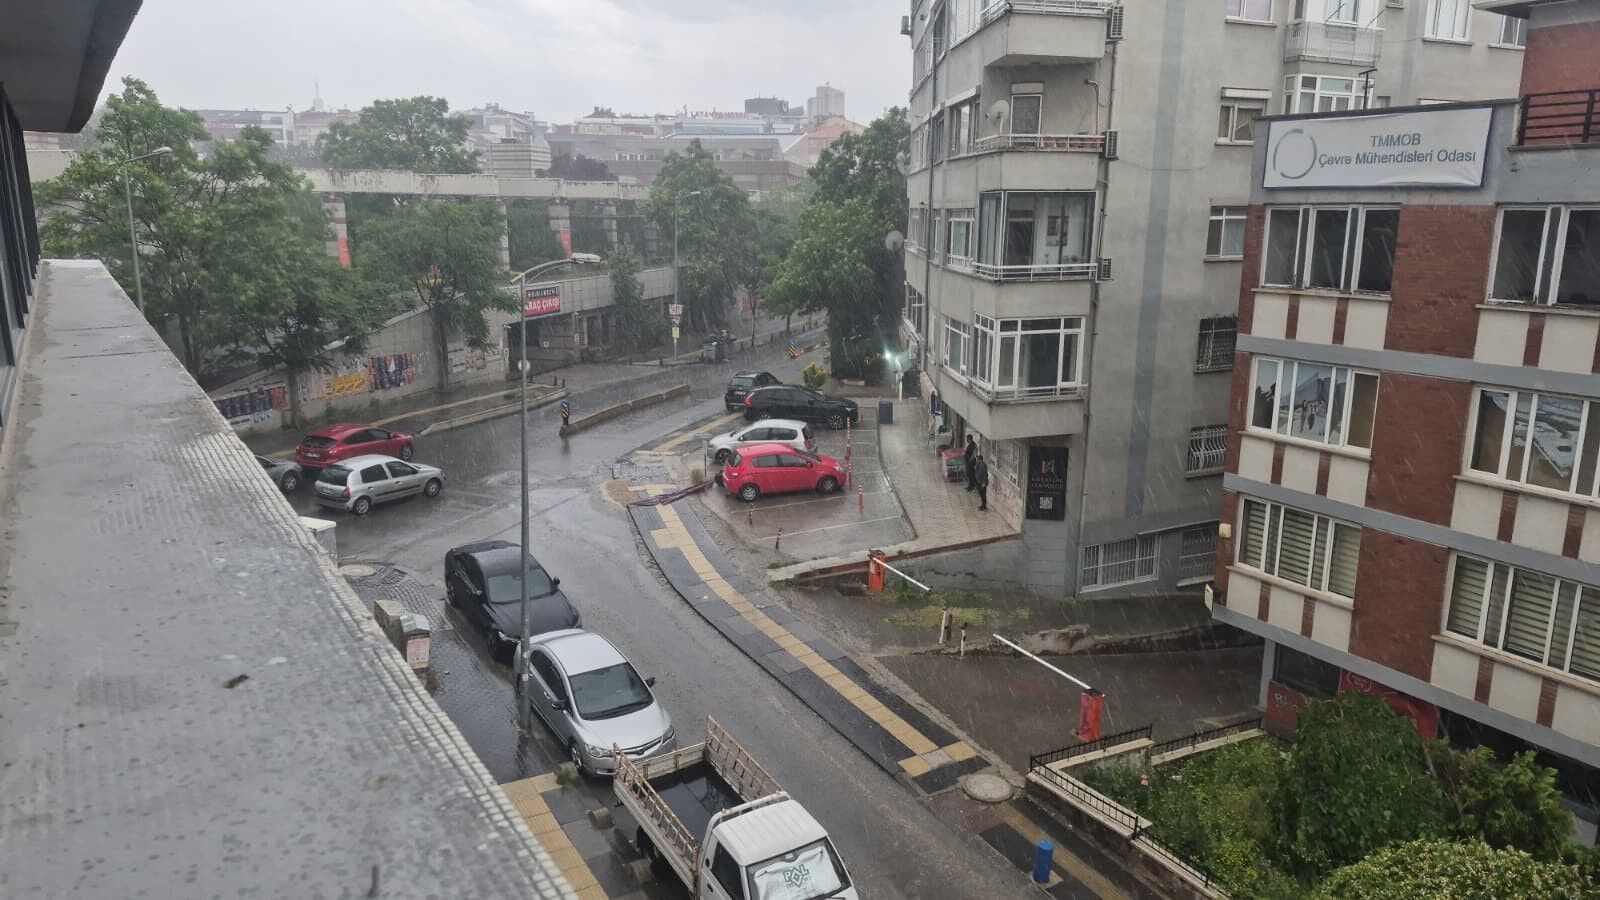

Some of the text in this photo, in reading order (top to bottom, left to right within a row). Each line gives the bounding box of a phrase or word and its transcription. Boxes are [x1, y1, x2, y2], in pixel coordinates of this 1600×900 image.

[1370, 133, 1422, 148] TMMOB
[1318, 149, 1476, 168] Çevre Mühendisleri Odası
